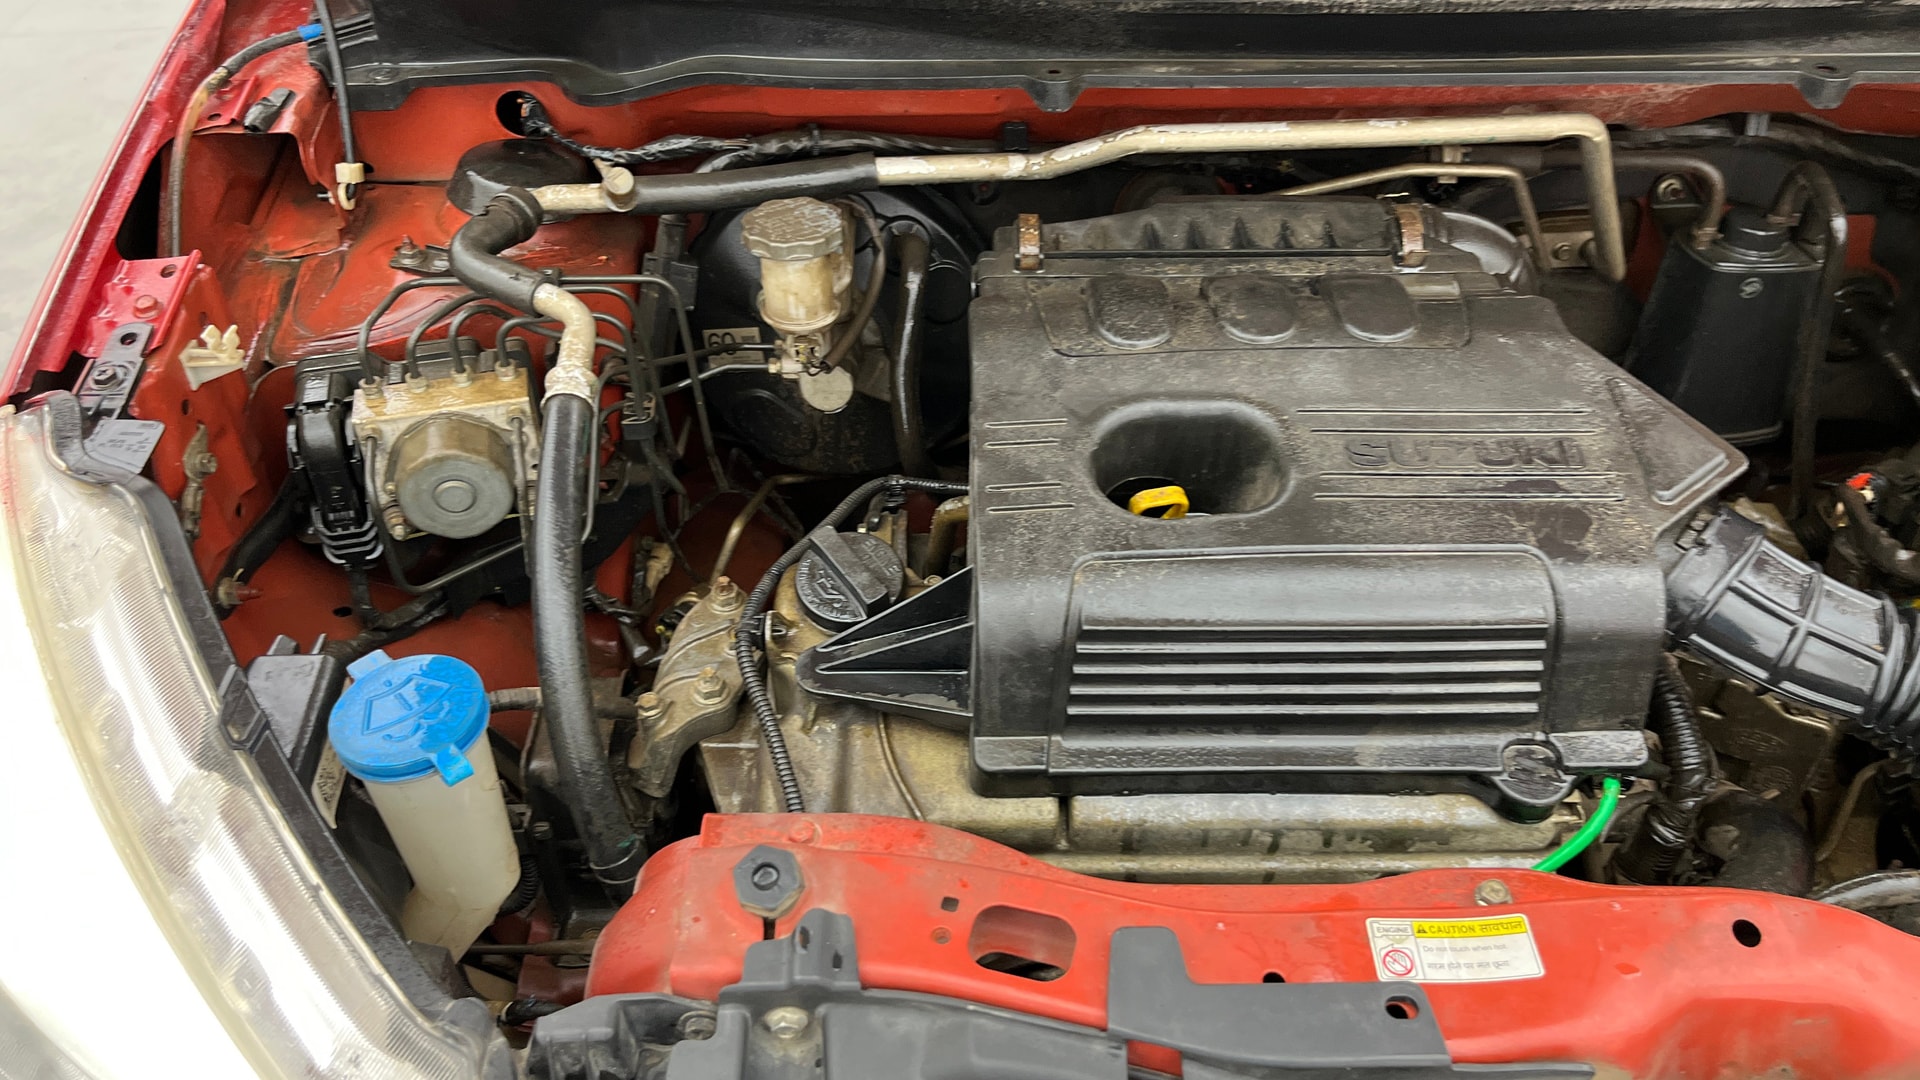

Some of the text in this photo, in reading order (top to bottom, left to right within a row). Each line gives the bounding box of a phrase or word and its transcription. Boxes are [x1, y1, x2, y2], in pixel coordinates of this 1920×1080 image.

[1343, 436, 1587, 469] SUZUKI
[1376, 926, 1410, 934] ENGINE
[1428, 921, 1523, 935] CAUTION सावधान
